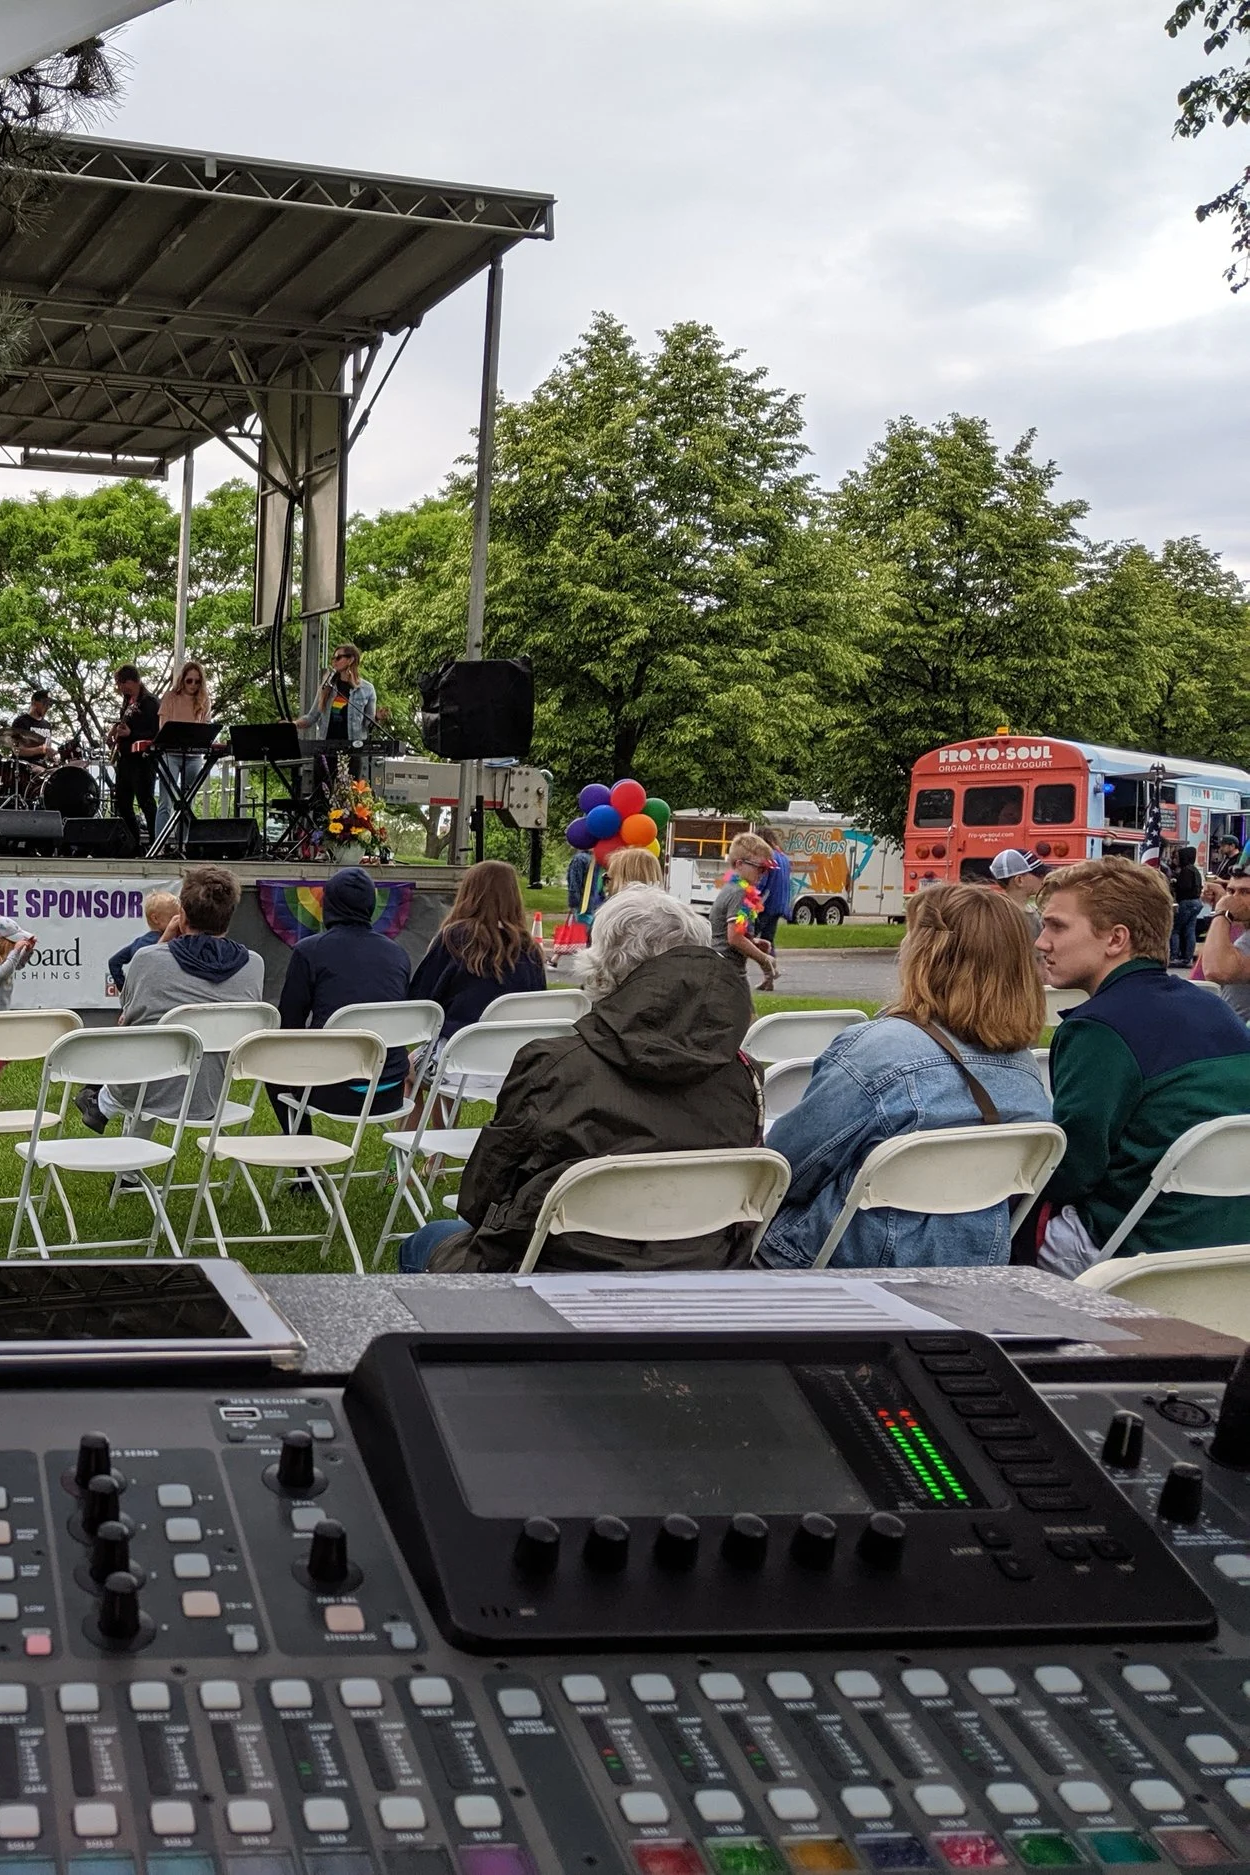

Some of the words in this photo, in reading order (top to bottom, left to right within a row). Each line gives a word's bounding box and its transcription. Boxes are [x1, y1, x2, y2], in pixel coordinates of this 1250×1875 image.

[938, 764, 977, 773] ORGANIC
[979, 762, 1014, 771] FROZEN
[1016, 761, 1053, 769] YOGURT
[805, 831, 847, 857] Chips
[25, 889, 143, 918] SPONSOR
[29, 937, 82, 967] oard
